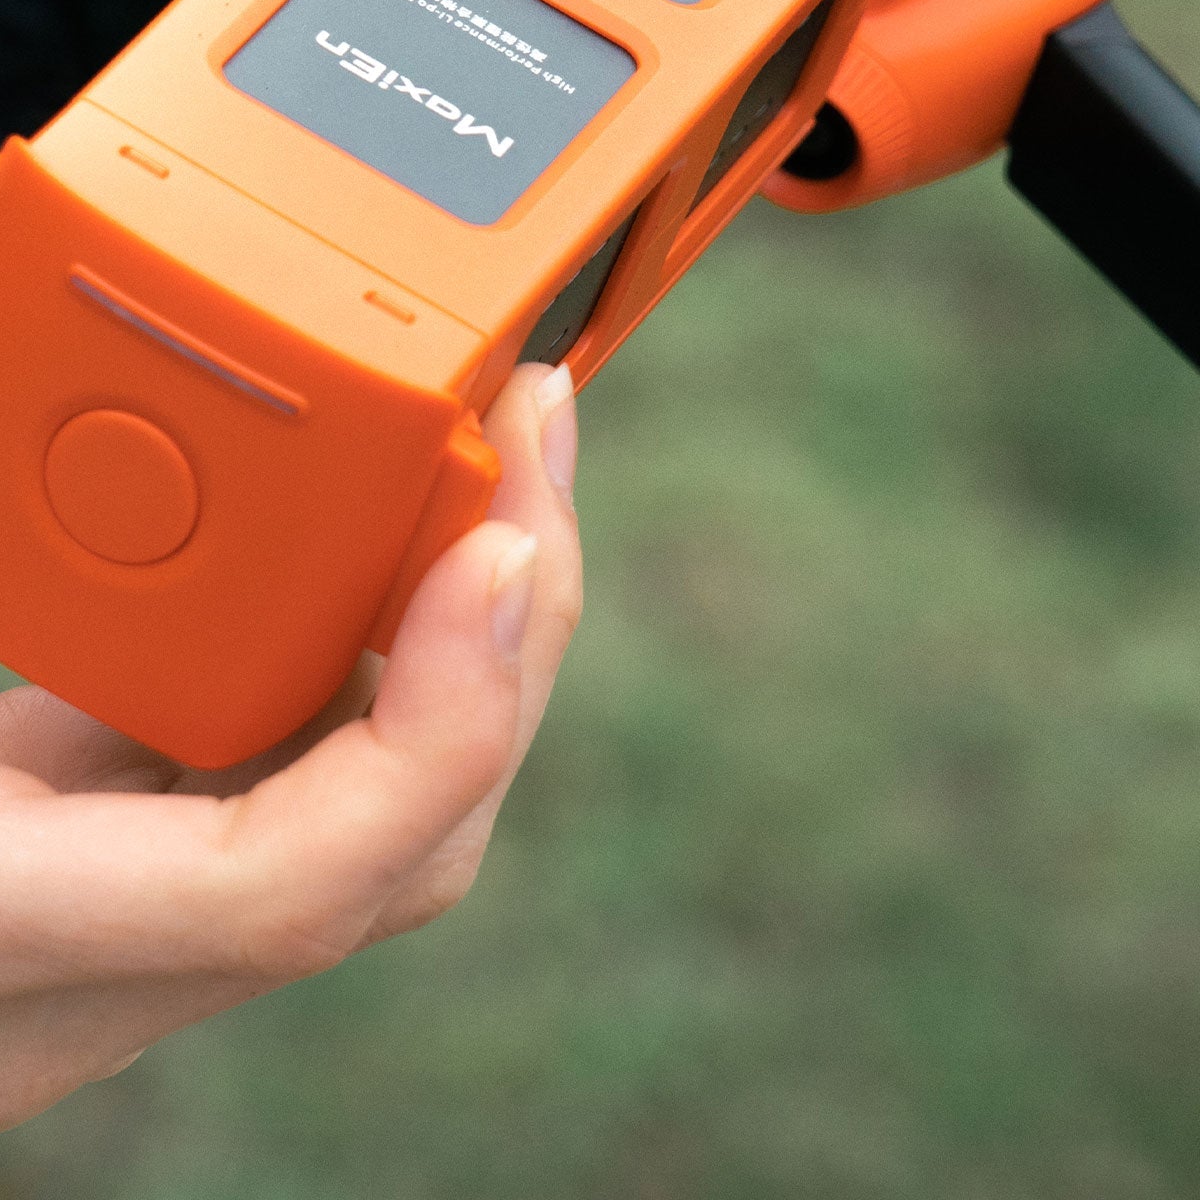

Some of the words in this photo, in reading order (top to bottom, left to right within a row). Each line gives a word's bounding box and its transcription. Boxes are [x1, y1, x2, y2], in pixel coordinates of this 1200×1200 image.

[418, 0, 453, 23] Li-po
[454, 20, 542, 74] Performance
[315, 30, 514, 157] MaxiEn
[543, 72, 575, 94] High
